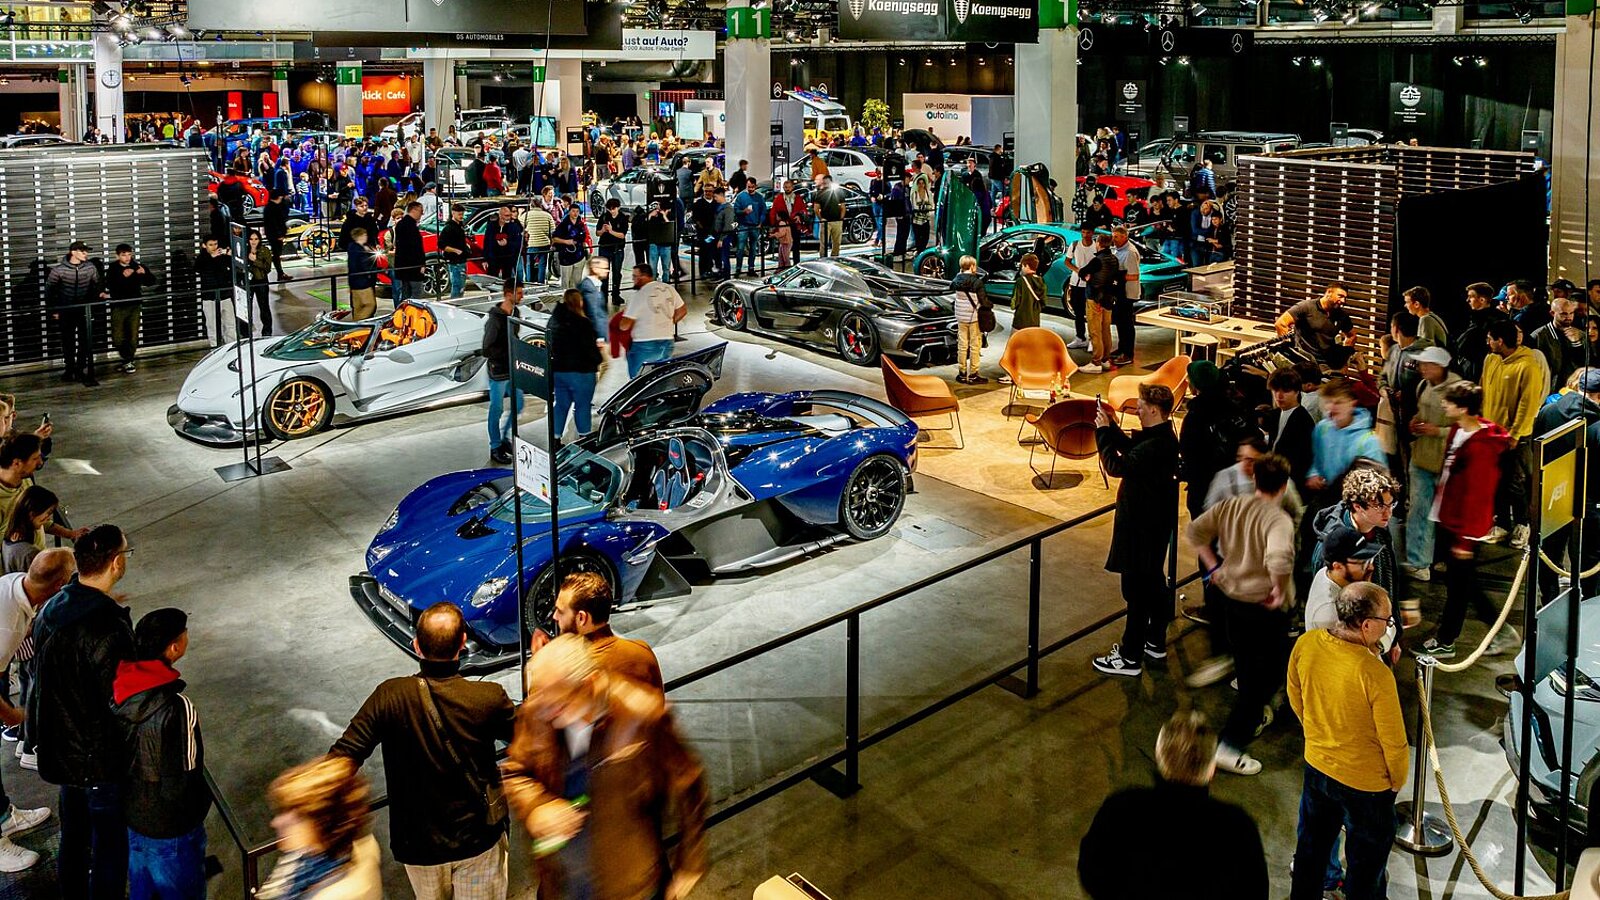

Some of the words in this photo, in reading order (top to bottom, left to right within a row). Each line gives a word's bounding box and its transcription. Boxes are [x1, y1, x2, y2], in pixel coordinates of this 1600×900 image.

[868, 0, 939, 15] Koenigsegg
[971, 3, 1032, 19] Koenigsegg
[1058, 0, 1069, 24] 1
[623, 37, 640, 46] ust
[642, 36, 659, 46] auf
[660, 37, 689, 46] Auto?
[348, 68, 357, 83] 1
[387, 90, 406, 99] Café
